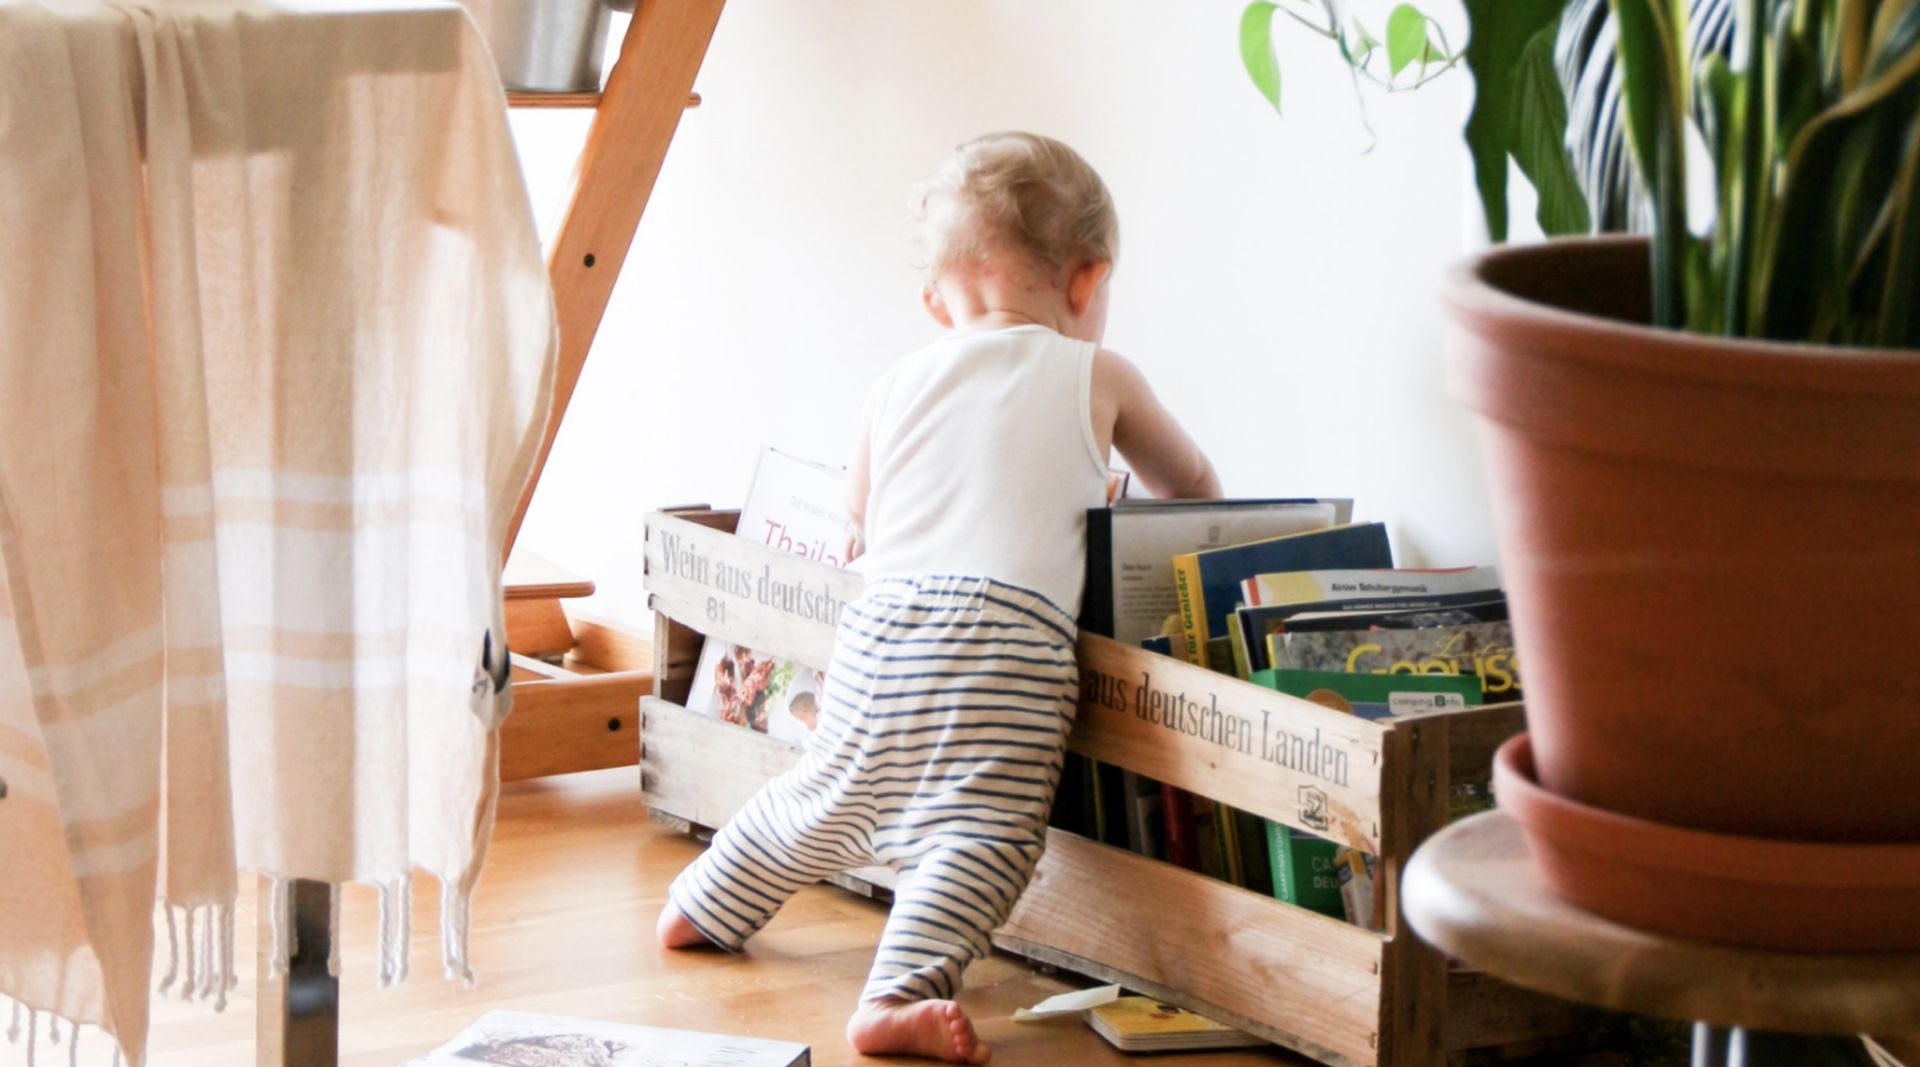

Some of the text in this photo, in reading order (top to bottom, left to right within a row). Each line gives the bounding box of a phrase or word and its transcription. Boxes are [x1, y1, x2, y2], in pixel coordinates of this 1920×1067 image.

[661, 530, 709, 585] Wein
[715, 561, 751, 600] aus
[707, 596, 727, 626] 81
[1087, 669, 1350, 788] aus deutschen Landen
